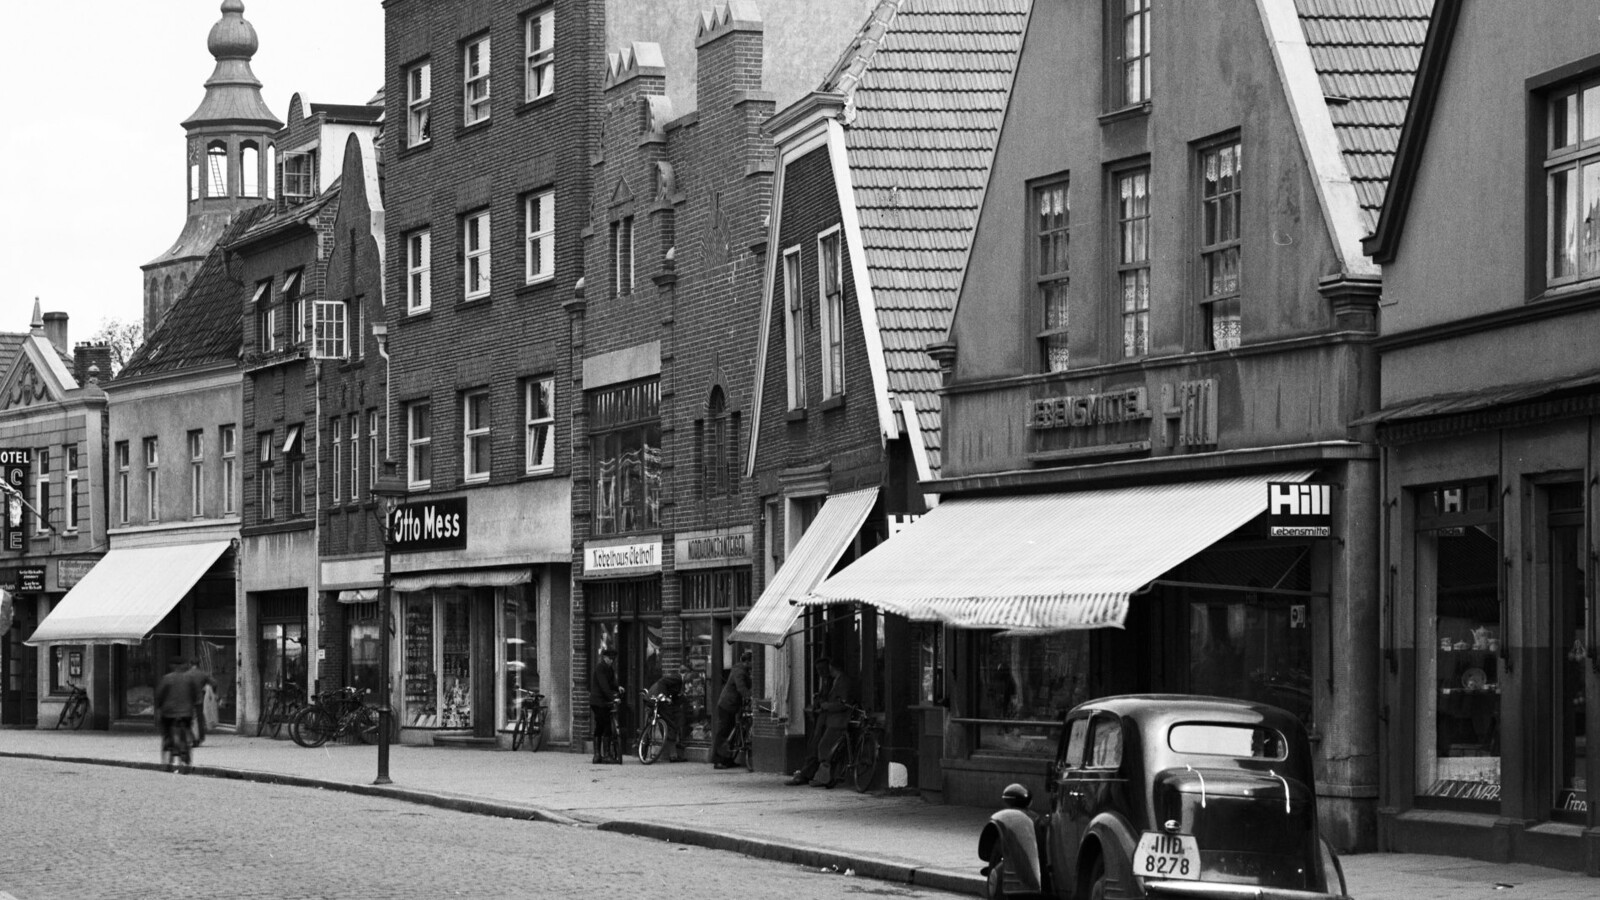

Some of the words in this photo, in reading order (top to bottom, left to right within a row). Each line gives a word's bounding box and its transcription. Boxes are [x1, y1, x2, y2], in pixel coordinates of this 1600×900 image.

[1270, 485, 1331, 515] Hill
[394, 508, 421, 543] Otto
[424, 505, 460, 540] Mess
[1271, 526, 1331, 536] Lebensmittel
[1145, 854, 1190, 876] 8278
